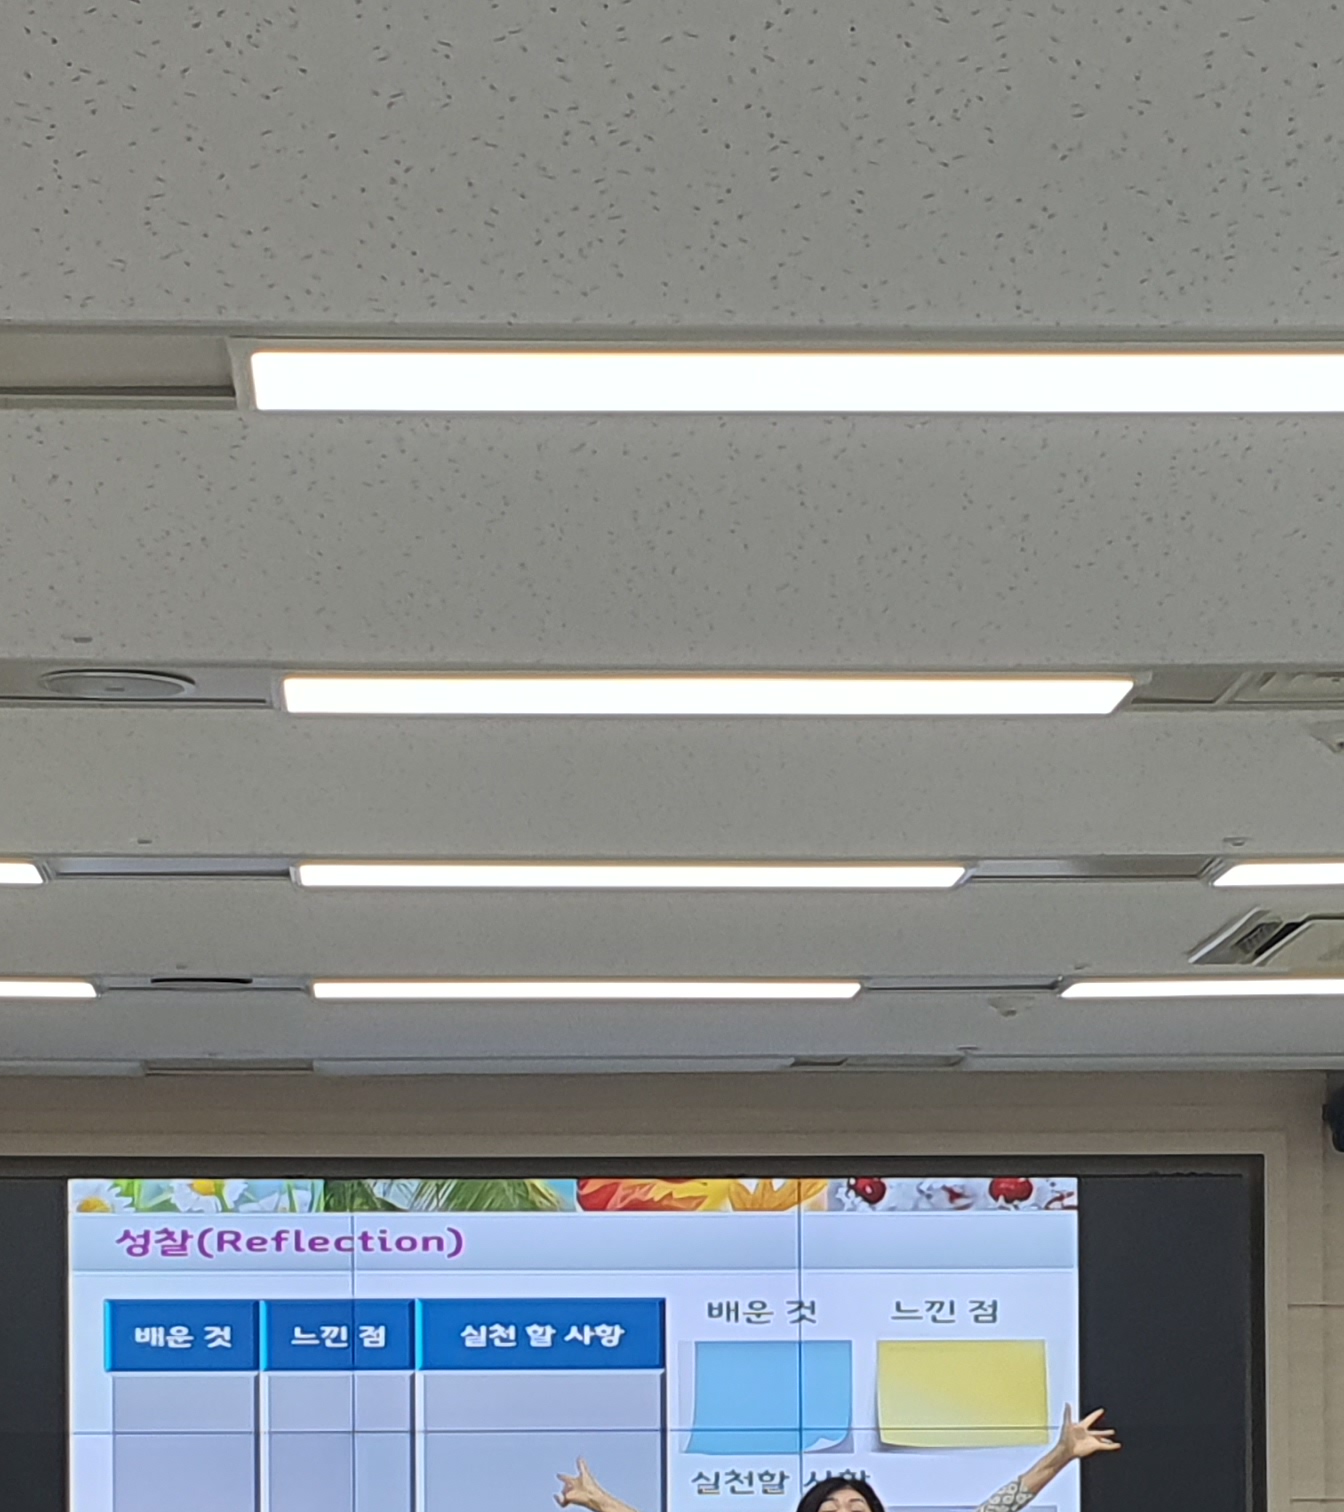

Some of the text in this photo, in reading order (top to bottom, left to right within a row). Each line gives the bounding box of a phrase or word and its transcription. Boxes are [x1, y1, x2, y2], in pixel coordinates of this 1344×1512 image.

[115, 1227, 464, 1259] 성찰(Reflection)
[706, 1298, 818, 1326] 배운 것
[890, 1299, 999, 1325] 느낀 점
[134, 1325, 232, 1348] 배운 것
[290, 1325, 387, 1348] 느낀 점
[460, 1323, 625, 1348] 실천 할 사항
[691, 1469, 790, 1495] 실천할
